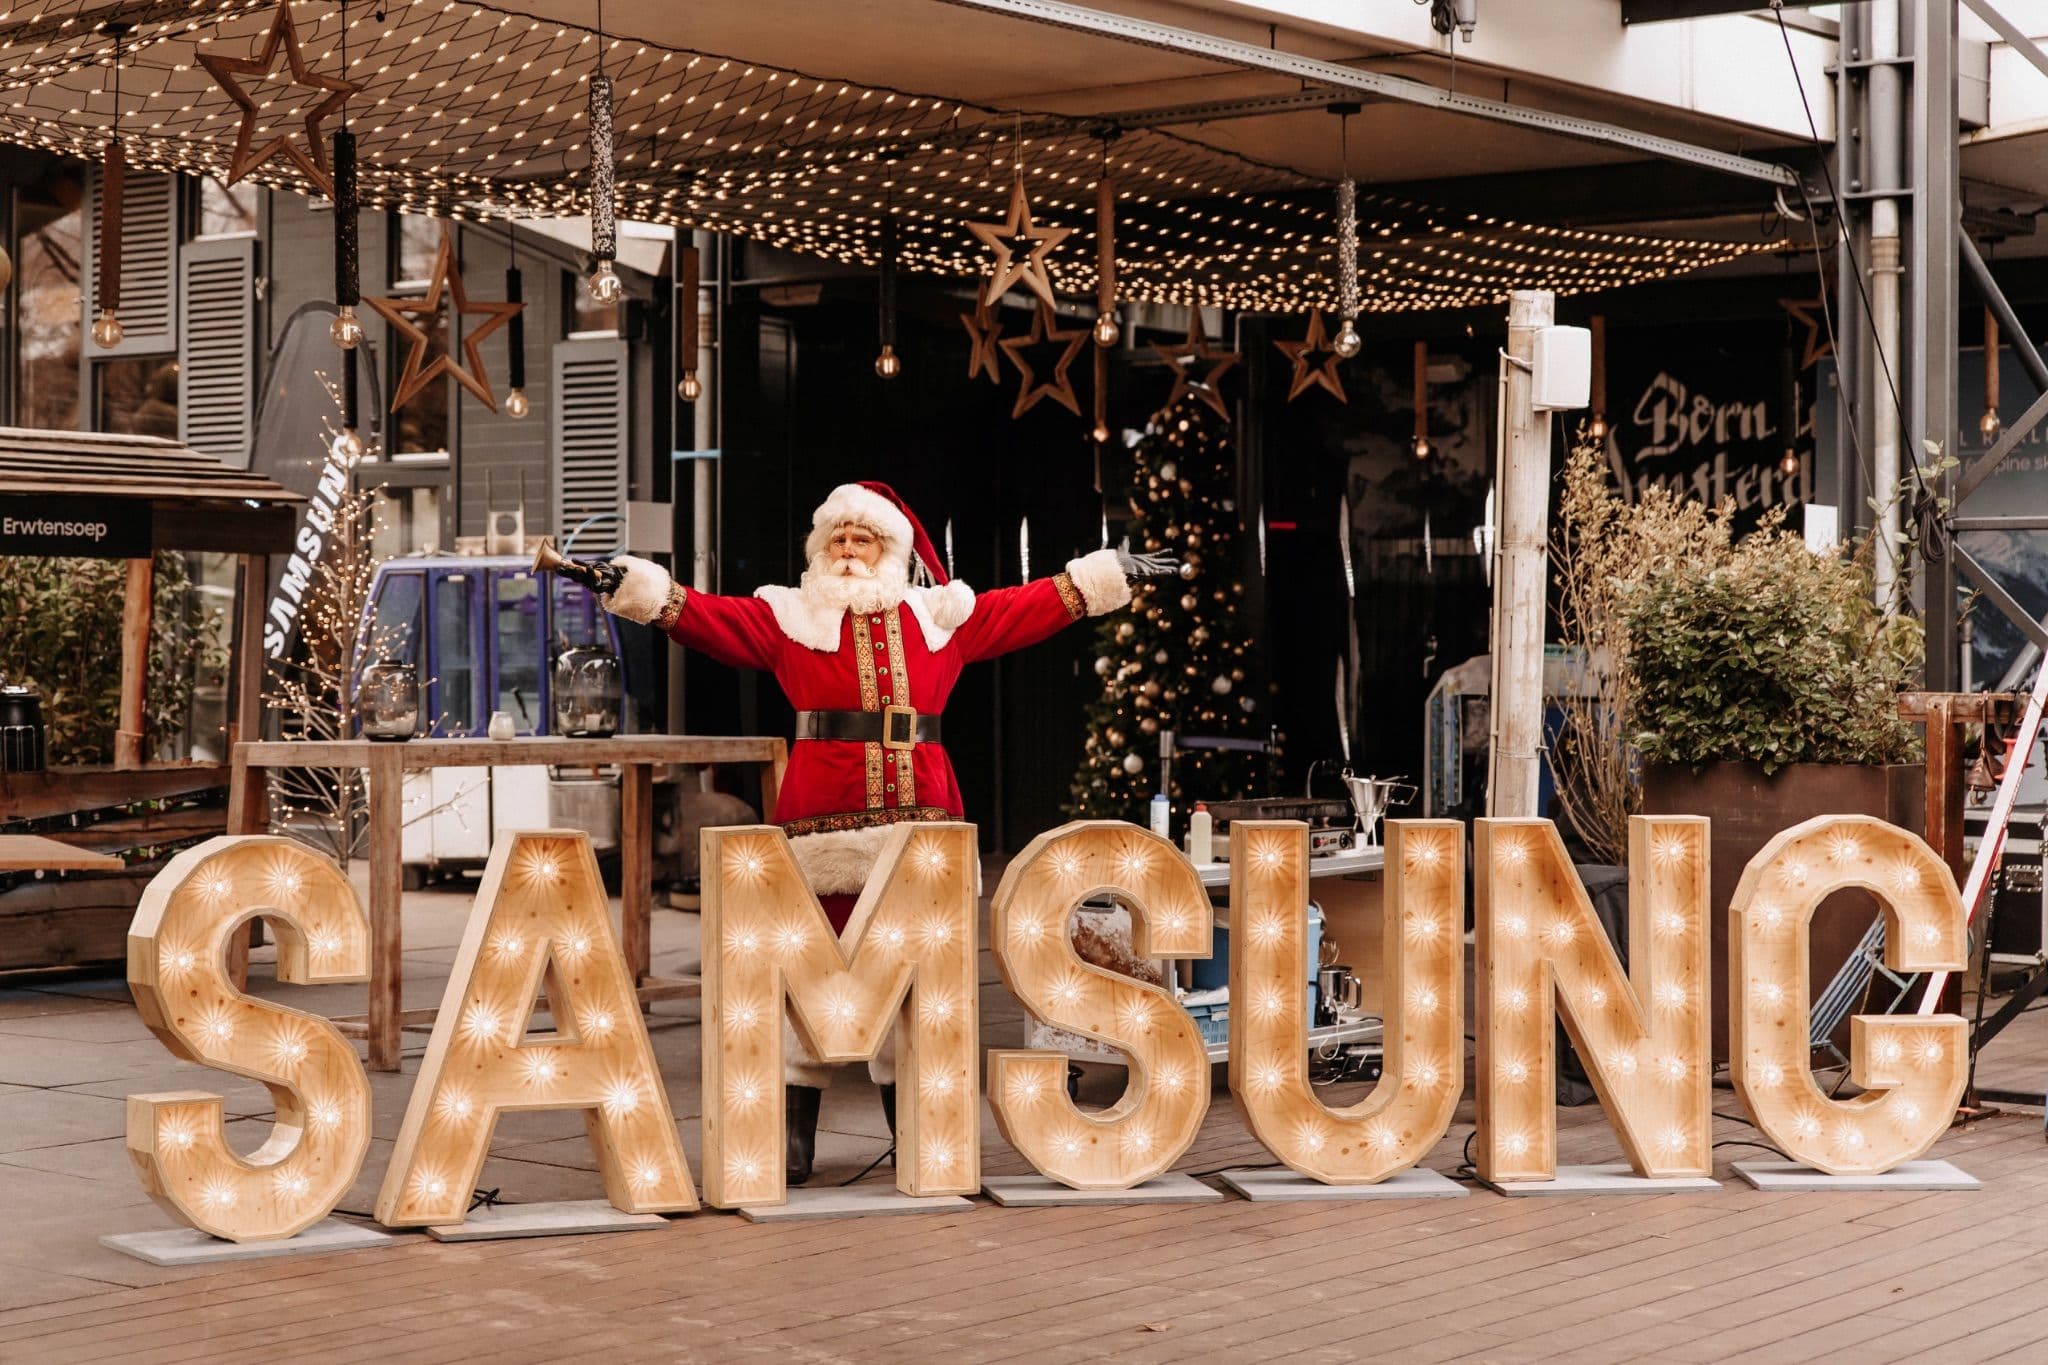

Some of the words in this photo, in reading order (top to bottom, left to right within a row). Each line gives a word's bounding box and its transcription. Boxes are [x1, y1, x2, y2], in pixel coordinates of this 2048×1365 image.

[1633, 371, 1776, 463] Born
[1605, 423, 1816, 511] Amsterd
[2, 517, 107, 542] Erwtensoep
[126, 813, 1969, 1243] SAMSUNG
